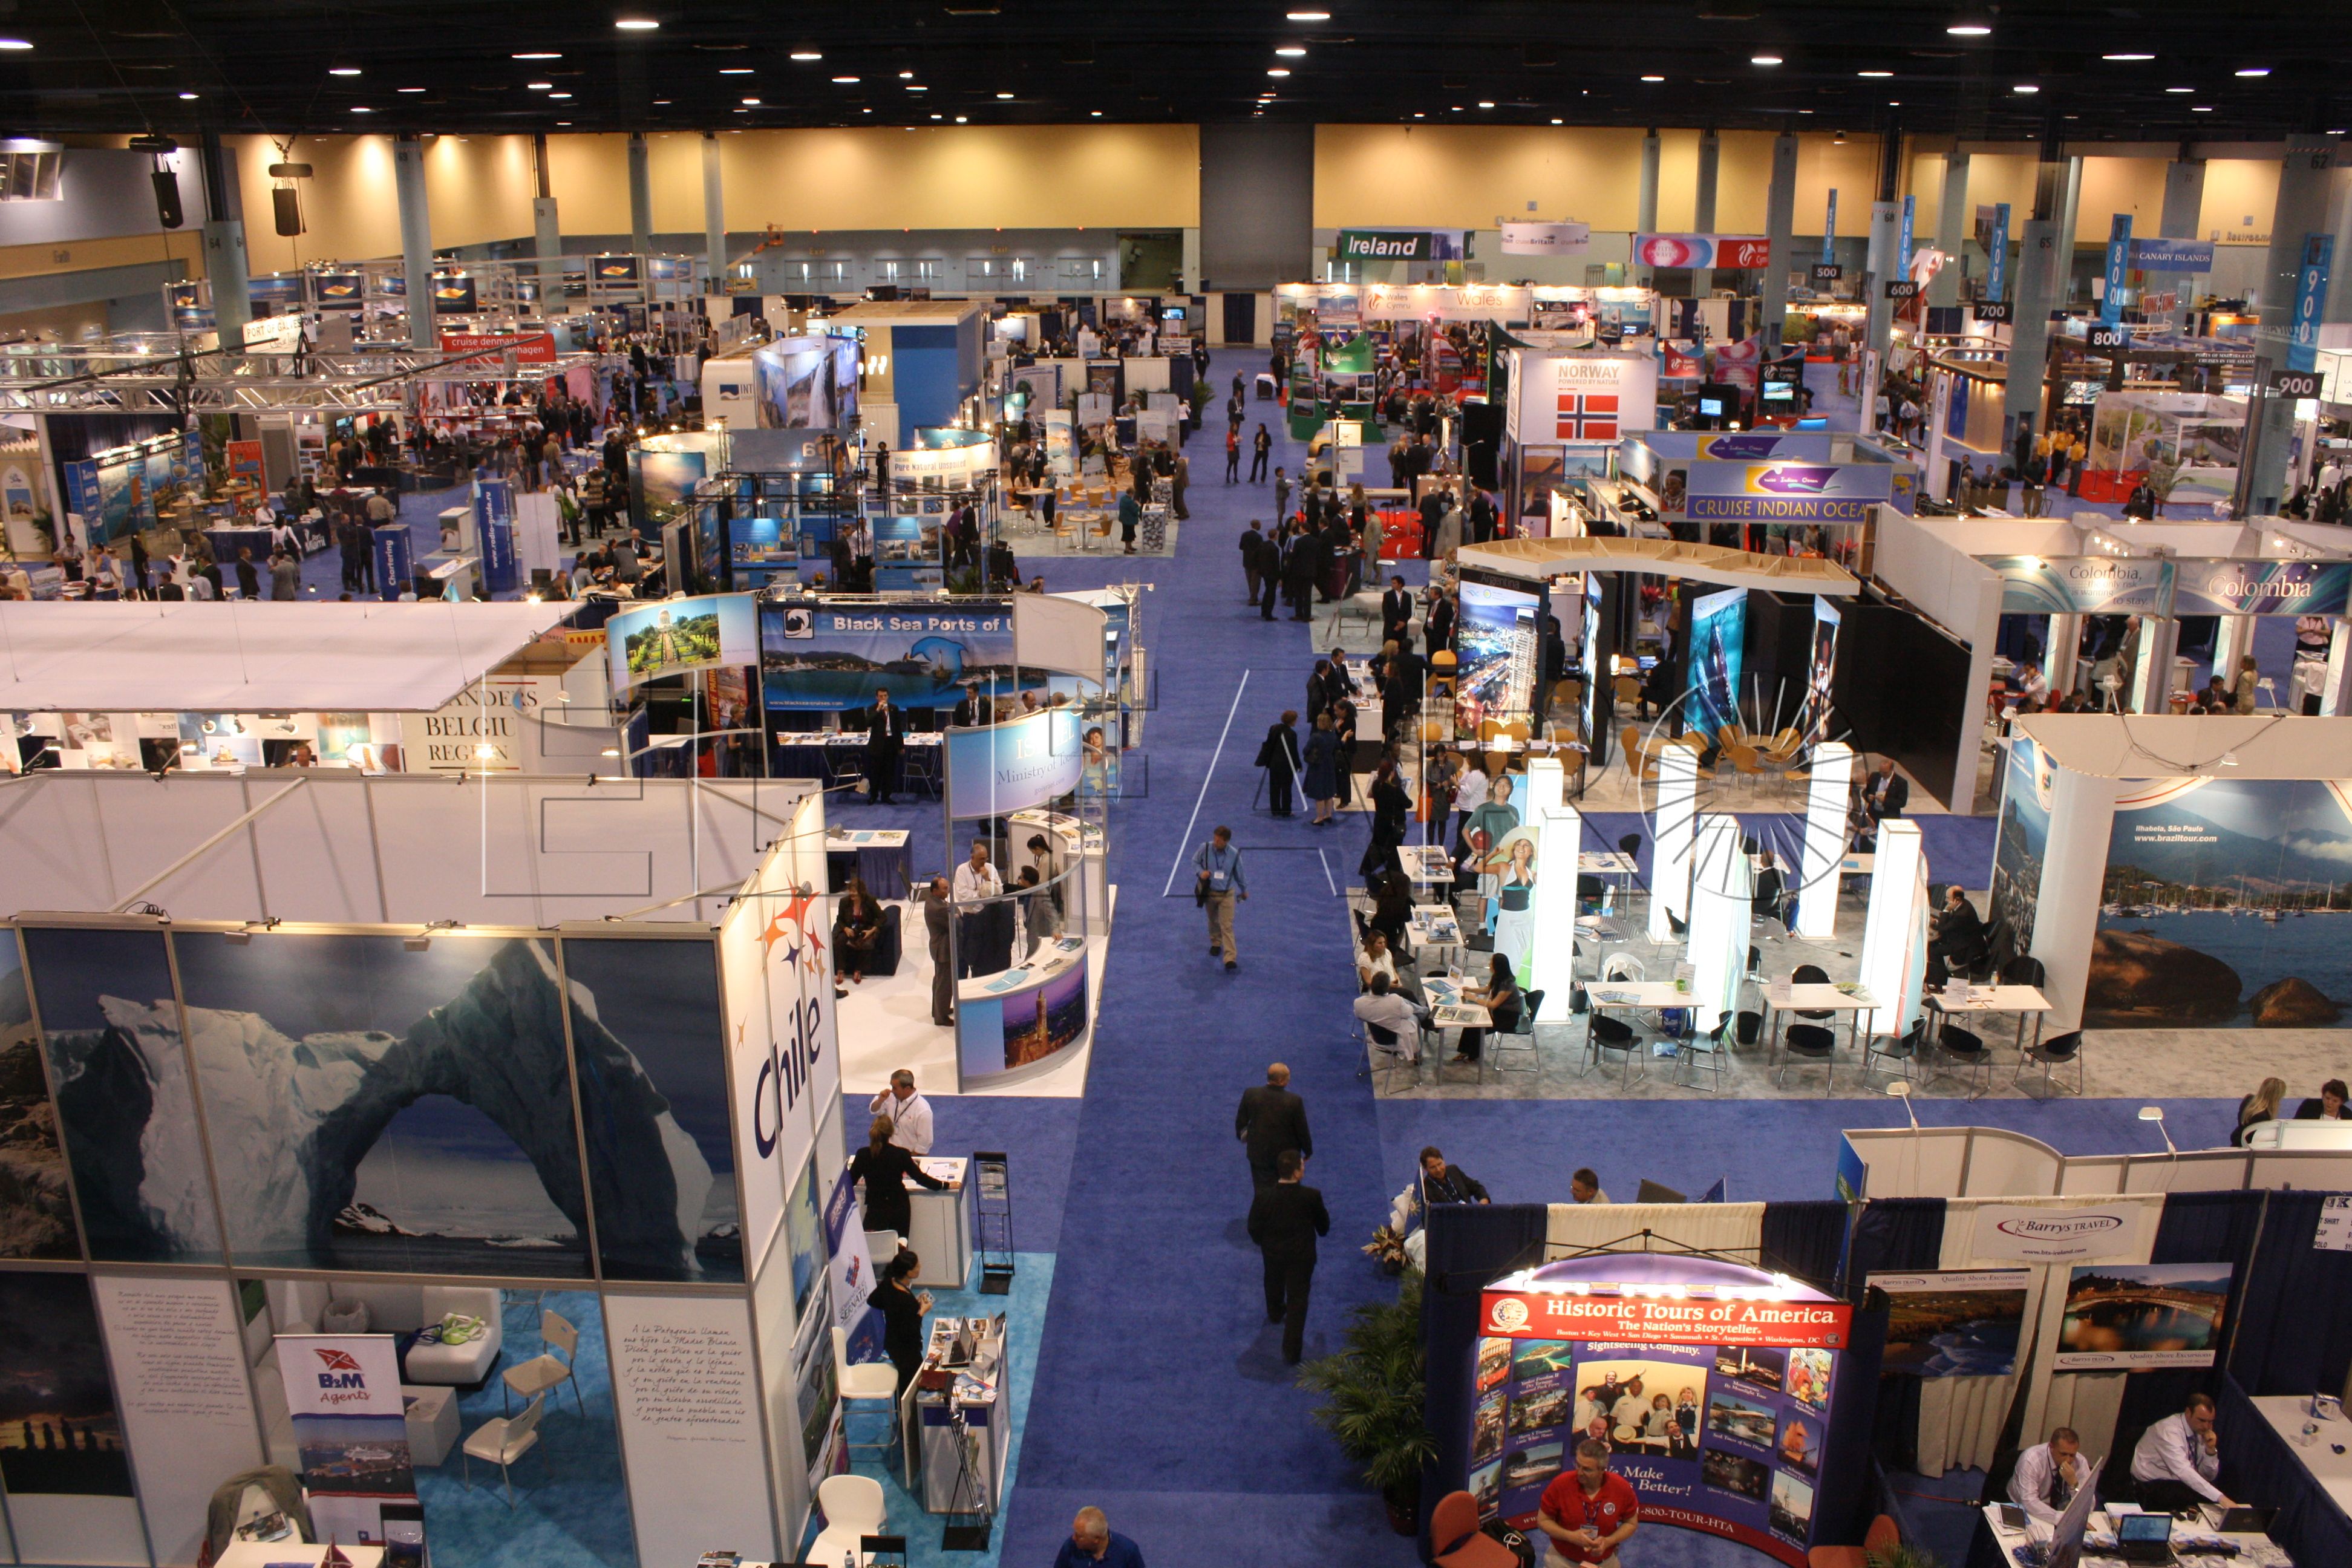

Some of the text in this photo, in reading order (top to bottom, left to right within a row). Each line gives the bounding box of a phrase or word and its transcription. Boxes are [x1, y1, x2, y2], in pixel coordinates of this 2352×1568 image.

[1348, 235, 1418, 255] Ireland
[1901, 219, 1910, 264] 600
[1993, 230, 2003, 283] 700
[2140, 252, 2211, 263] CANARY ISLANDS
[1817, 269, 1837, 278] 500
[2110, 245, 2122, 305] 800
[1891, 285, 1913, 295] 600
[1386, 302, 1411, 310] Cymru
[1457, 293, 1503, 306] Wales
[2299, 269, 2318, 344] 900
[1981, 305, 2005, 318] 700
[247, 325, 264, 338] PORT
[2094, 332, 2121, 345] 800
[480, 337, 518, 345] denmark
[1558, 365, 1619, 378] NORWAY
[2279, 377, 2313, 394] 900
[939, 459, 967, 470] Unspoiled
[1696, 500, 1867, 518] CRUISE INDIAN OCEA
[486, 491, 498, 569] www.radio-guide.ru
[386, 540, 396, 586] Chartering
[1480, 572, 1520, 590] Argentina
[2069, 566, 2142, 582] Colombia,
[2208, 575, 2312, 598] Colombia
[834, 616, 1002, 632] Black Sea Ports of
[710, 694, 718, 705] OF
[425, 717, 517, 737] BELGIU
[997, 761, 1056, 786] Ministry of
[2026, 1221, 2070, 1235] Barrys
[2074, 1219, 2112, 1232] TRAVEL
[1942, 1275, 1965, 1283] Quality
[1546, 1299, 1834, 1324] Historic Tours of America
[653, 1324, 697, 1337] Patagonia
[1617, 1320, 1641, 1331] The
[1643, 1321, 1692, 1332] Nation's
[1765, 1336, 1806, 1344] Washington,
[1650, 1342, 1700, 1356] Company.
[318, 1373, 365, 1390] B&M
[320, 1390, 371, 1405] Agents
[1624, 1466, 1664, 1480] Make
